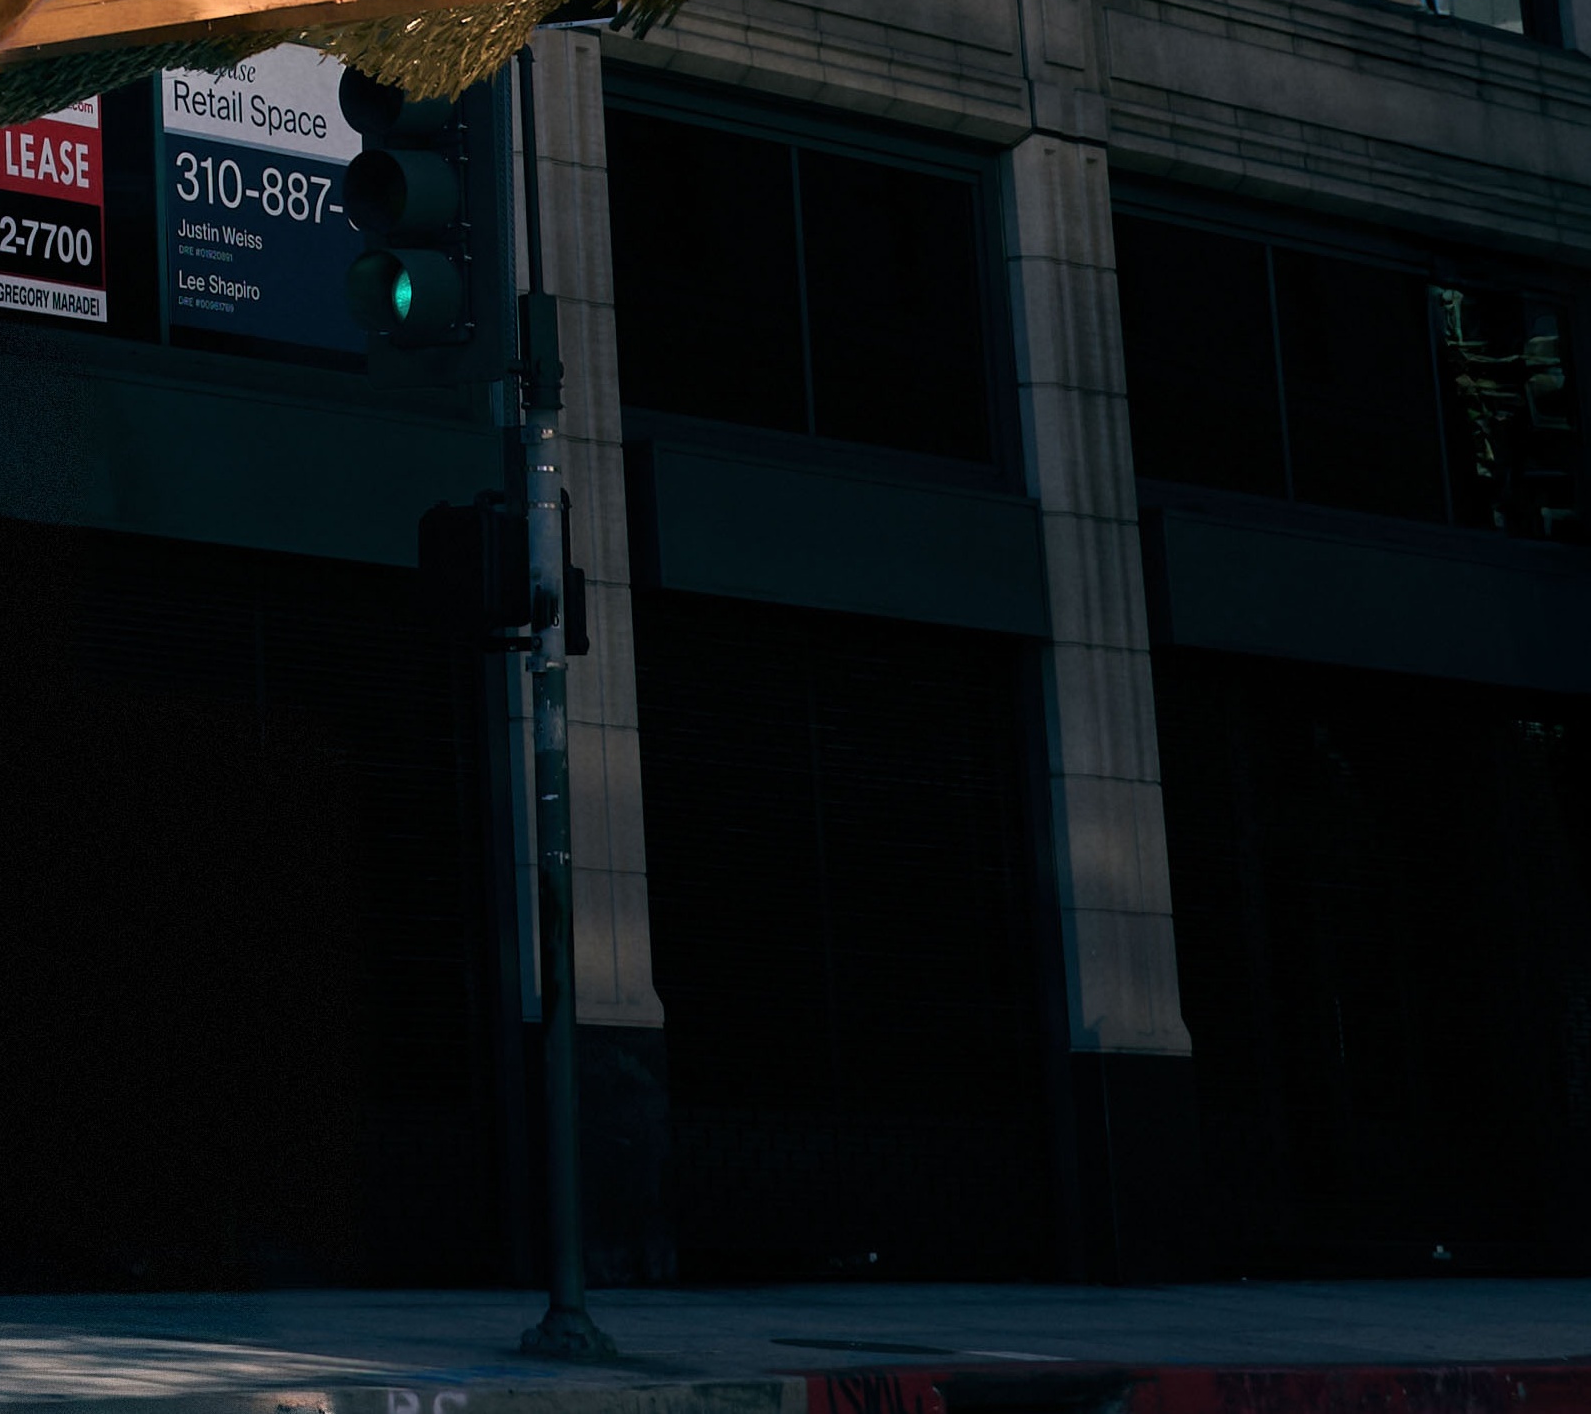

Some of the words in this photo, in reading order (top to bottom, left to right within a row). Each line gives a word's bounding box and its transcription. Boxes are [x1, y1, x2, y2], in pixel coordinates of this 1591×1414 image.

[174, 80, 243, 124] Retail
[250, 95, 327, 139] Space
[5, 130, 90, 189] LEASE
[177, 218, 220, 243] Justin
[222, 226, 263, 251] Weiss
[178, 269, 205, 292] Lee
[208, 274, 261, 301] Shapiro
[52, 292, 99, 316] MARADEI
